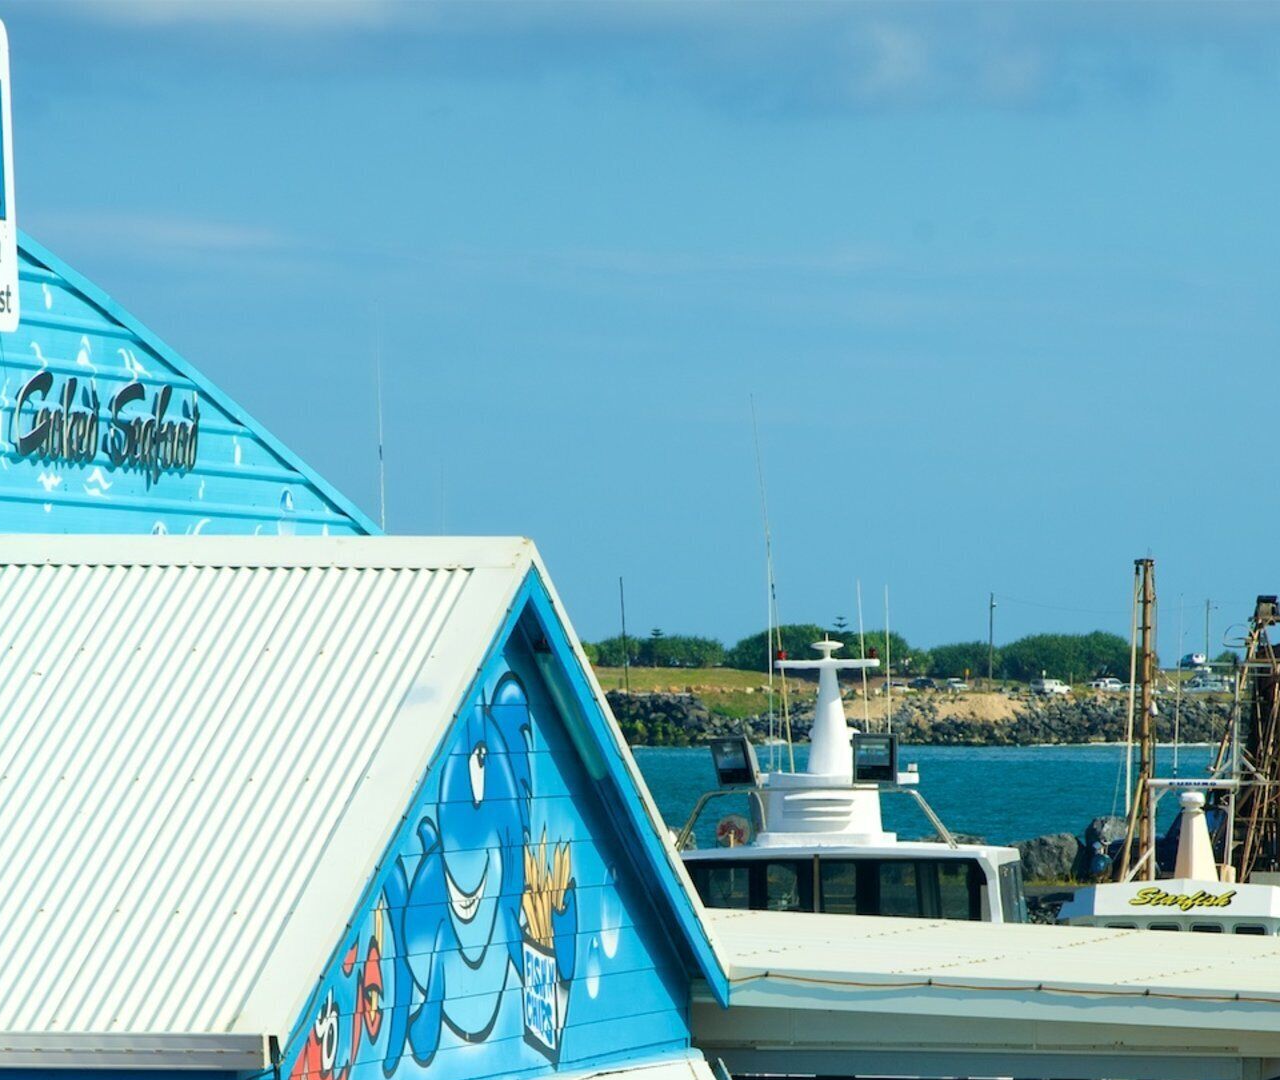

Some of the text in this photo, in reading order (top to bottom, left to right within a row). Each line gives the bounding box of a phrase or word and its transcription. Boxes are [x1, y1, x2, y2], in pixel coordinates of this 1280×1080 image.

[16, 371, 200, 485] Cooked Seafood
[1128, 886, 1237, 912] Starfish
